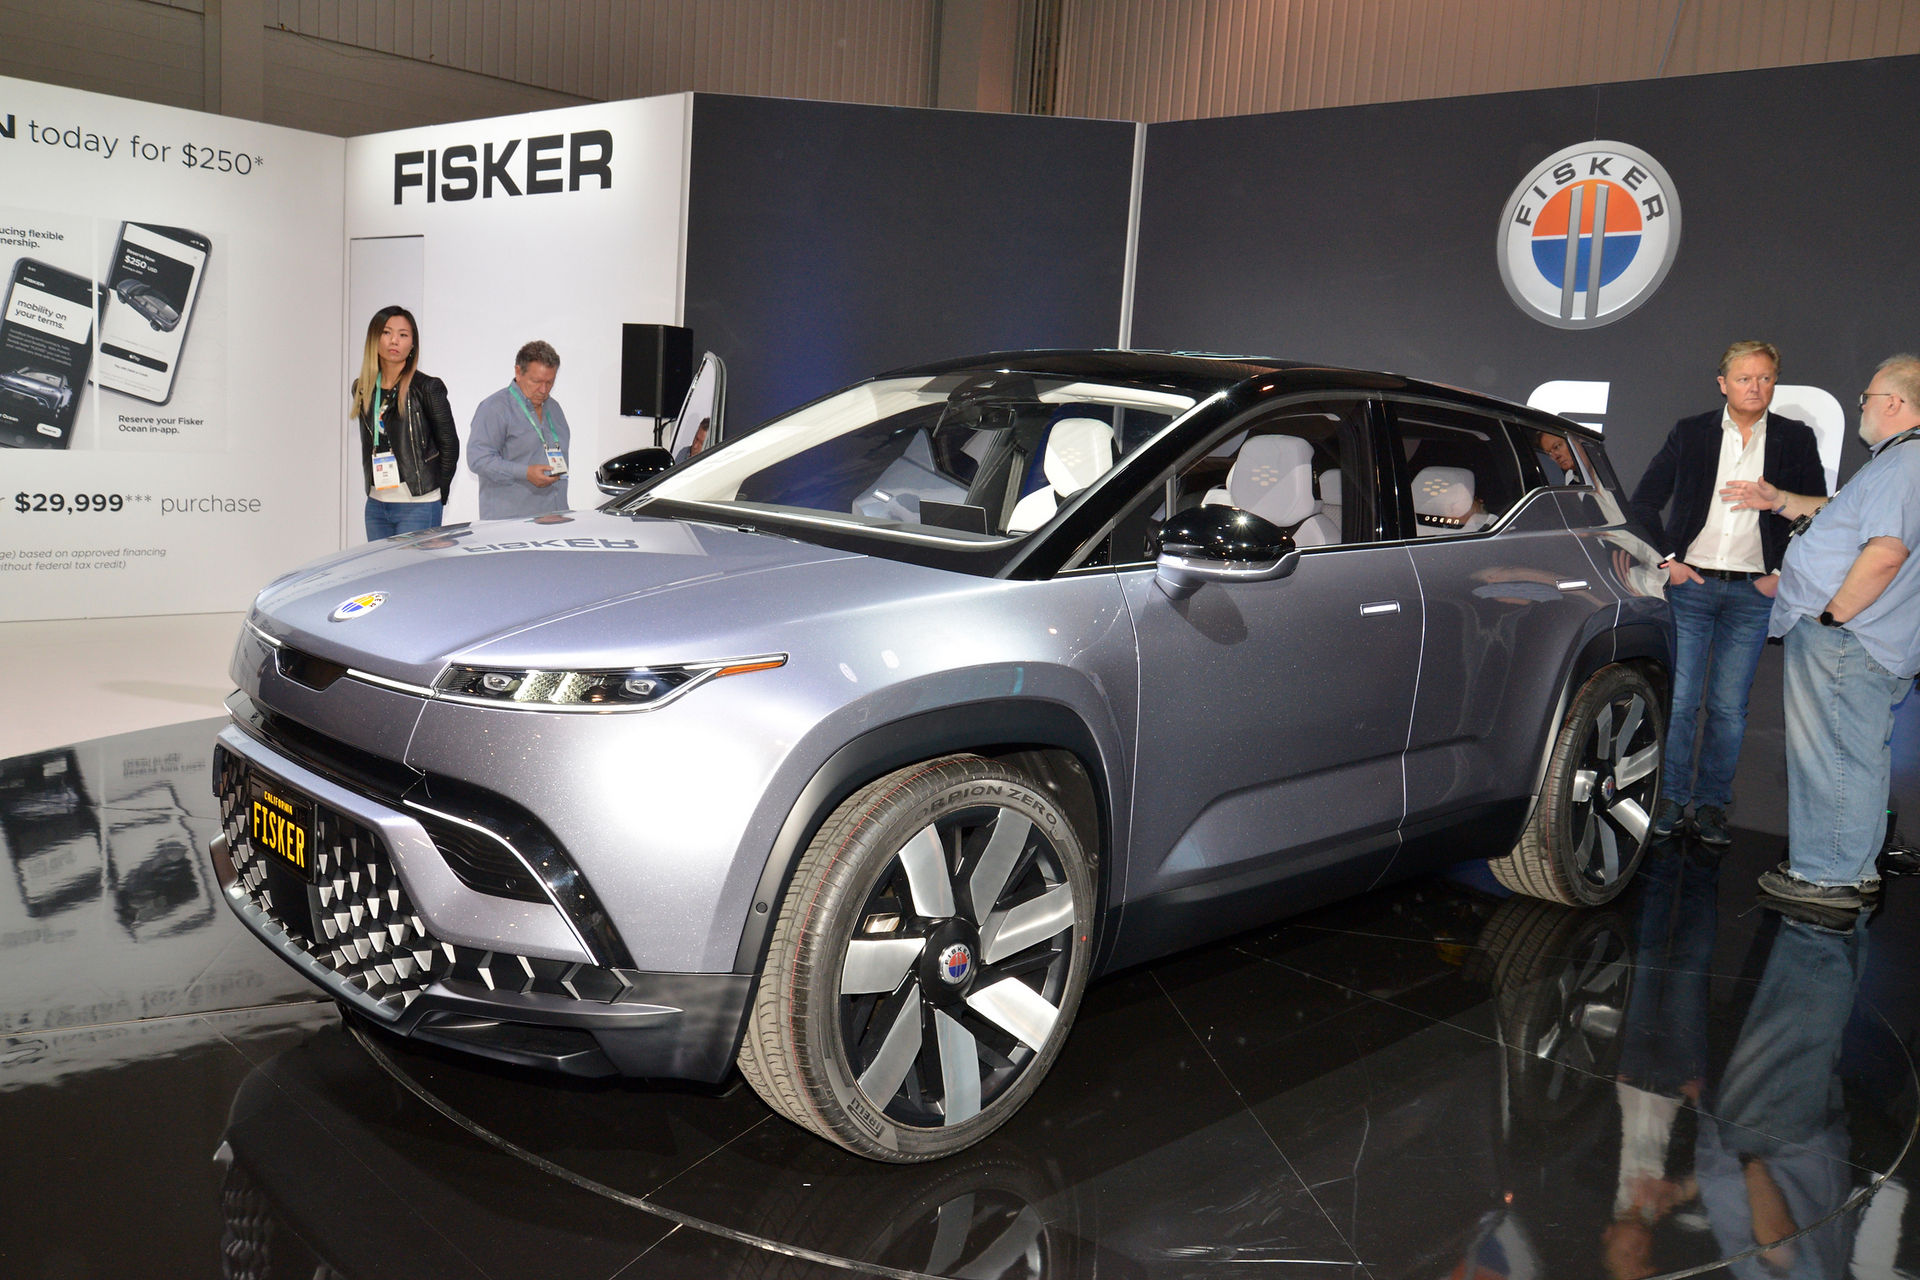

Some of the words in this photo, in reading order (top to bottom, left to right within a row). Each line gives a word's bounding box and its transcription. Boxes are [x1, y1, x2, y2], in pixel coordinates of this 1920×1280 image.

[28, 120, 119, 159] today
[130, 135, 172, 163] for
[394, 129, 613, 205] FISKER
[1515, 157, 1665, 227] FISKER
[28, 229, 64, 241] flexible
[123, 255, 147, 269] $250
[15, 308, 36, 320] your
[37, 315, 65, 330] terms.
[17, 299, 54, 317] mobility
[55, 312, 67, 321] on
[118, 414, 154, 424] Reserve
[156, 416, 176, 425] your
[178, 417, 204, 426] Fisker
[118, 424, 148, 433] Ocean
[149, 425, 180, 435] in-app.
[161, 495, 262, 516] purchase
[19, 550, 51, 559] based
[55, 550, 69, 558] on
[71, 549, 120, 559] approved
[122, 547, 167, 558] financing
[34, 561, 73, 571] federal
[74, 561, 91, 570] tax
[93, 560, 127, 570] credit)
[263, 790, 293, 815] CALIFORNIA
[1007, 788, 1058, 826] ZERO
[253, 800, 305, 869] FISKER
[846, 1097, 886, 1138] PIRELLI
